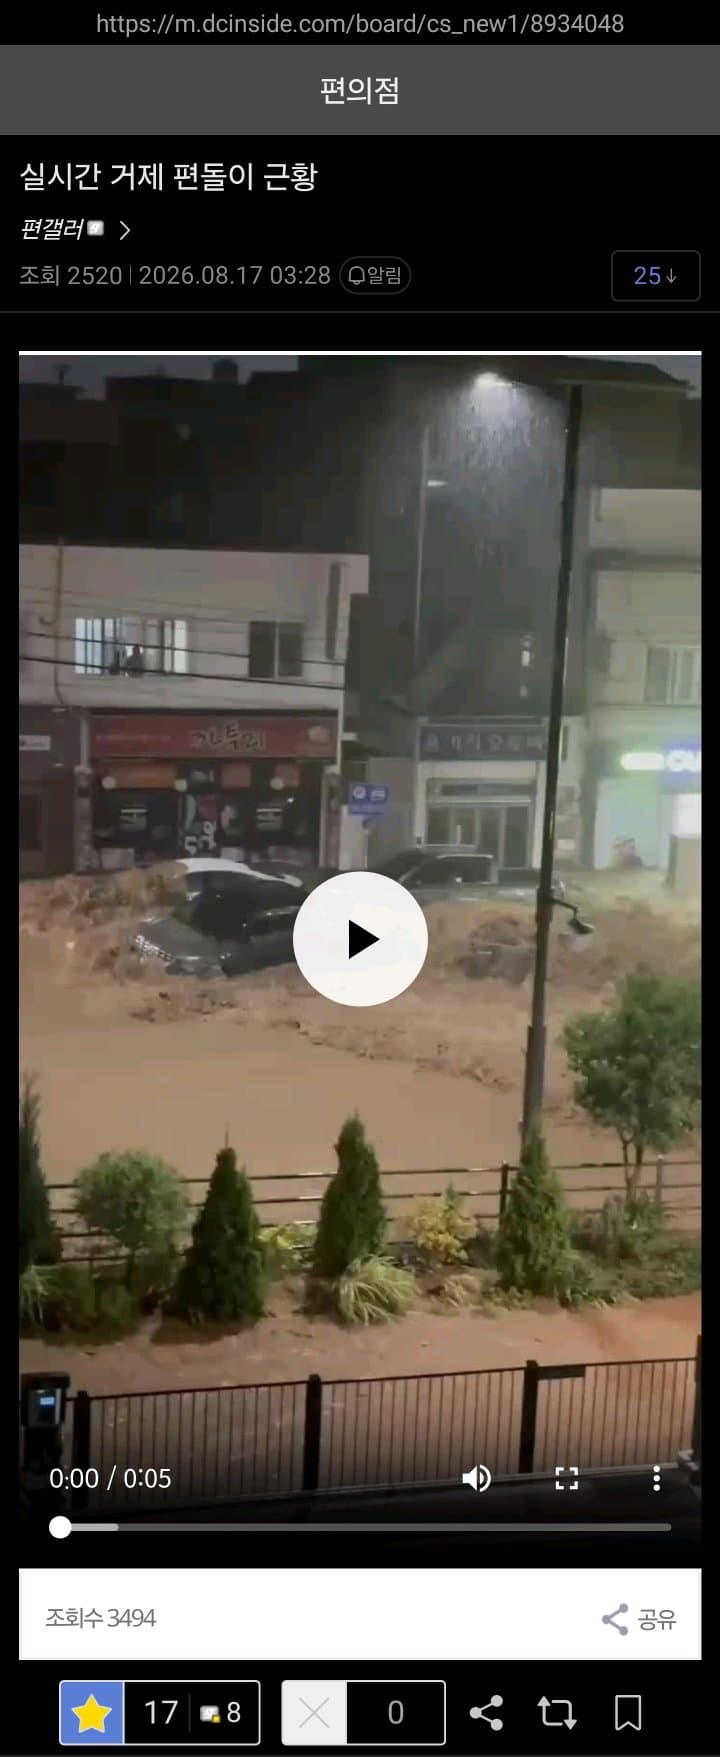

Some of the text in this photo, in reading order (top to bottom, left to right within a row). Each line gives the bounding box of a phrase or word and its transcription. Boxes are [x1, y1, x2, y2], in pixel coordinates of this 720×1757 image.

[96, 12, 625, 38] https://m.dcinside.com/board/cs_new1/8934048
[320, 76, 399, 106] 편의점
[19, 162, 319, 192] 실시간 거제 편돌이 근황
[21, 217, 85, 241] 편갤러
[19, 264, 122, 287] 조회 2520
[139, 265, 331, 285] 2026.08.17 03:28
[367, 264, 402, 286] 알림
[633, 265, 662, 286] 25
[49, 1467, 99, 1490] 0:00
[124, 1467, 172, 1490] 0:05
[45, 1606, 157, 1630] 조회수 3494
[637, 1607, 678, 1632] 공유
[144, 1699, 179, 1725] 17
[227, 1701, 241, 1724] 8
[388, 1699, 404, 1725] 0
